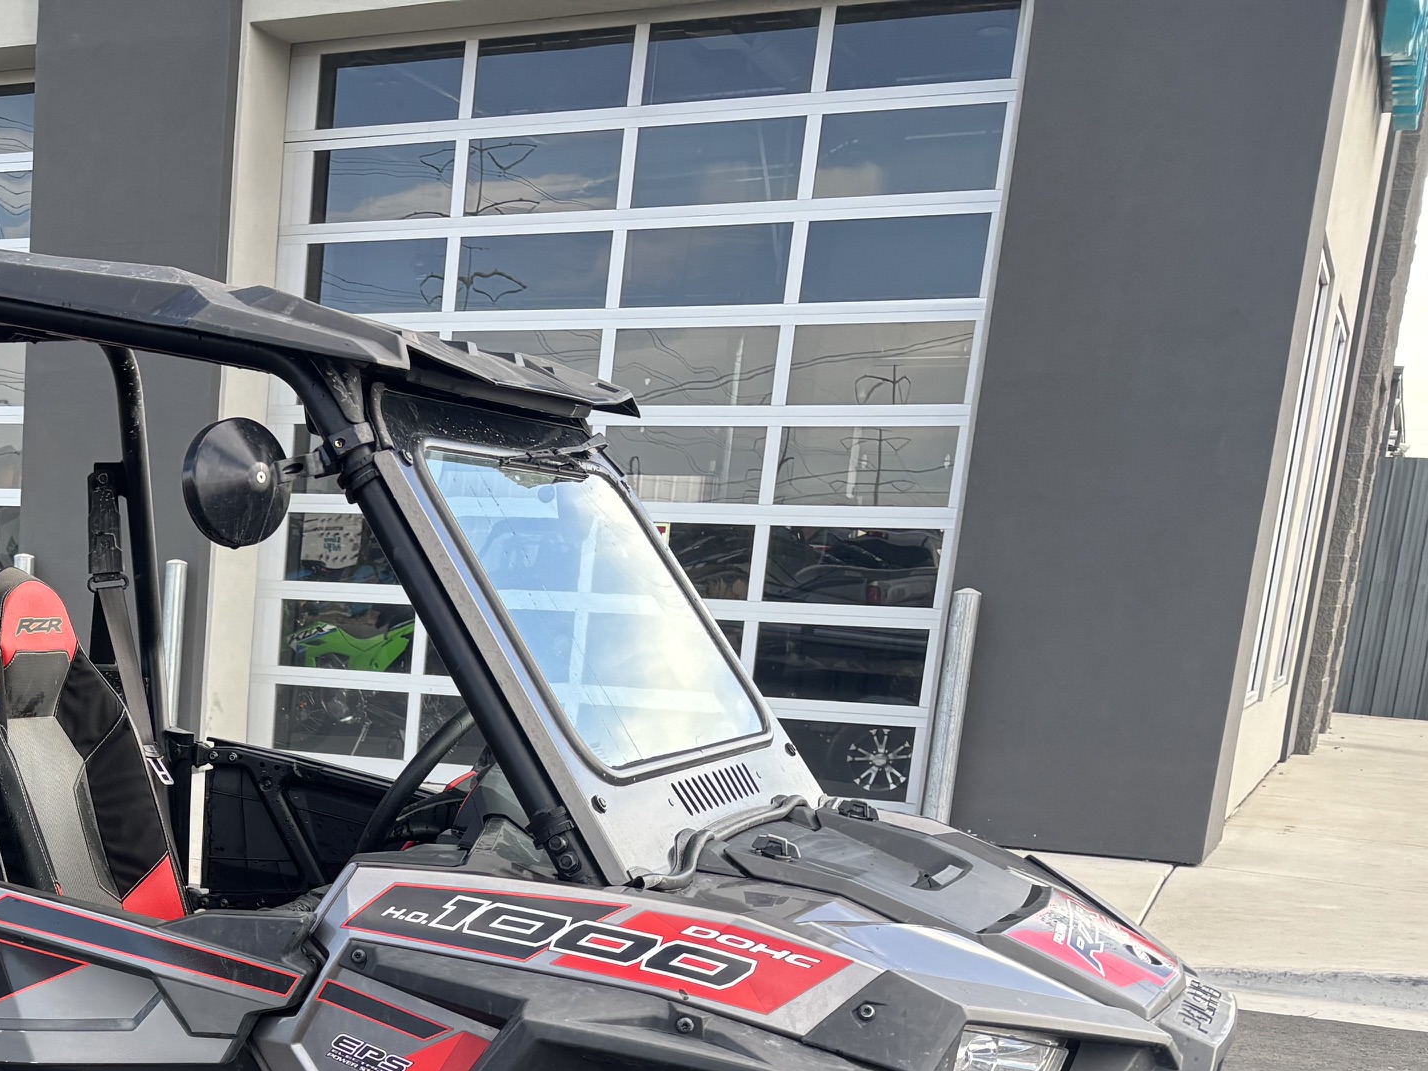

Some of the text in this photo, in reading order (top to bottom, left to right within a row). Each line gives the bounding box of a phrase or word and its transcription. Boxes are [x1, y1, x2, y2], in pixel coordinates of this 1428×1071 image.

[15, 616, 63, 637] RZR
[381, 894, 823, 991] H.O. 1000 DOHC
[327, 1053, 359, 1068] POWER
